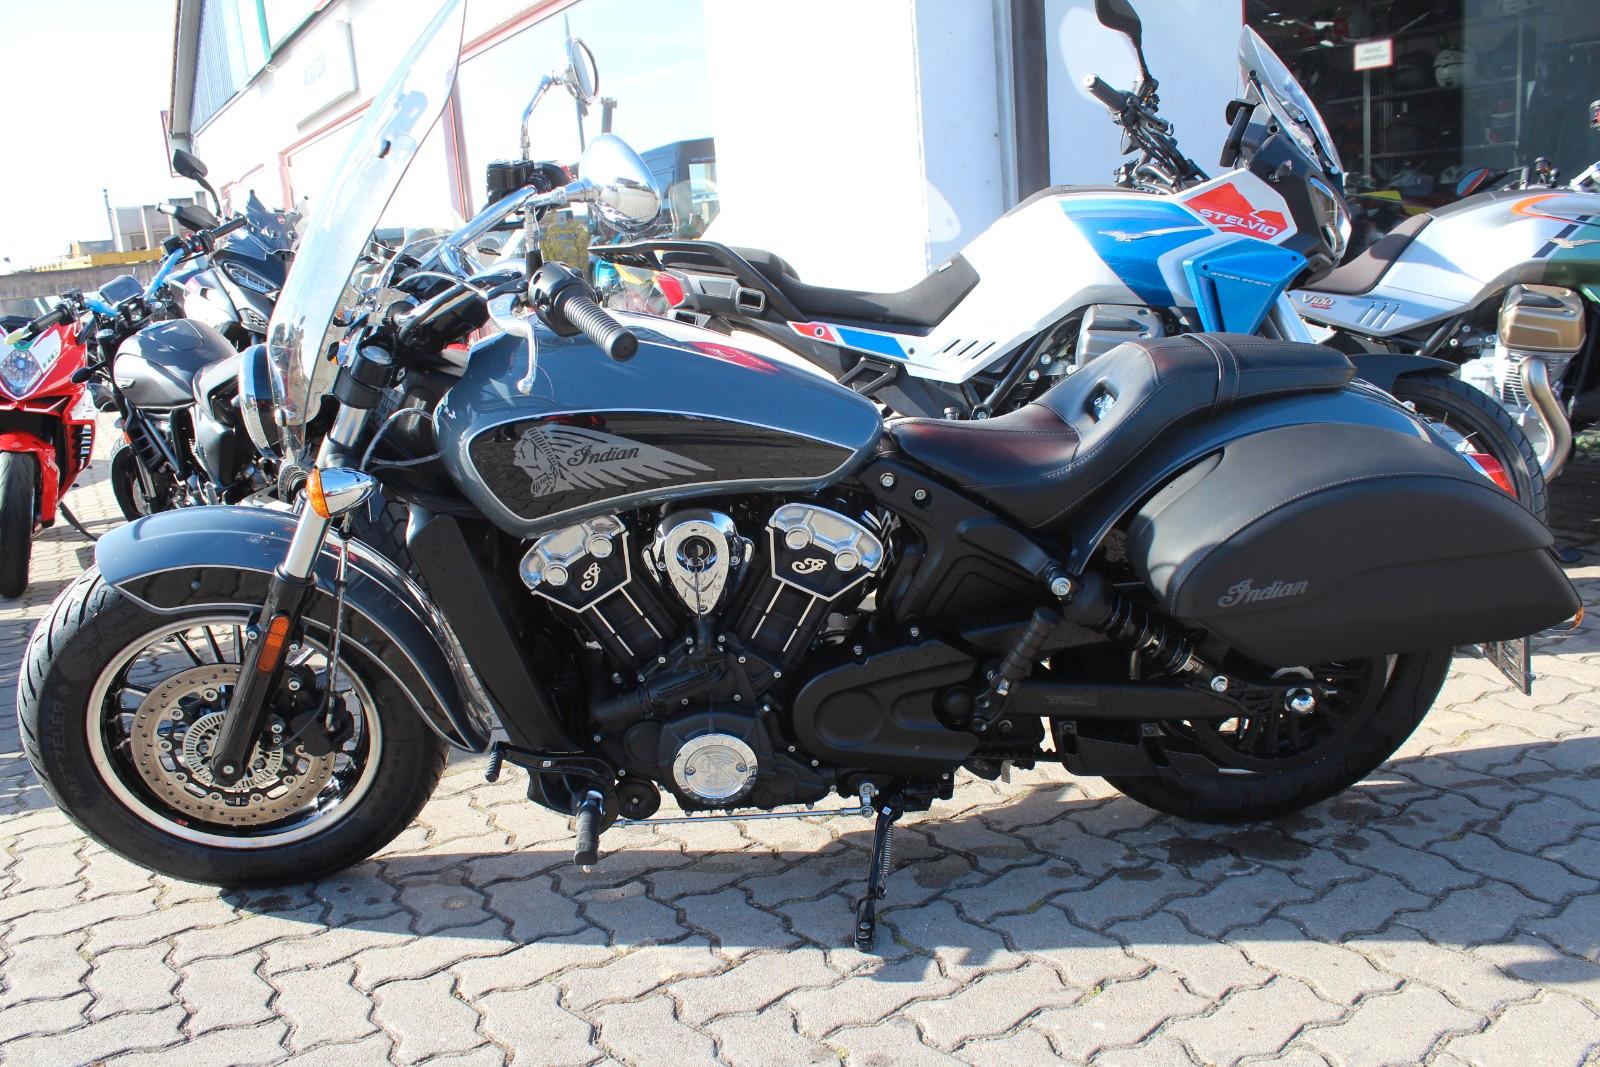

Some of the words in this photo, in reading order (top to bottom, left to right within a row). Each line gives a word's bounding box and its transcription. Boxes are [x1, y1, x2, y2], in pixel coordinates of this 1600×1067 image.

[1199, 208, 1278, 236] STELVIO
[567, 444, 640, 467] Indian
[1217, 579, 1308, 608] Indian
[51, 700, 86, 800] METZELER
